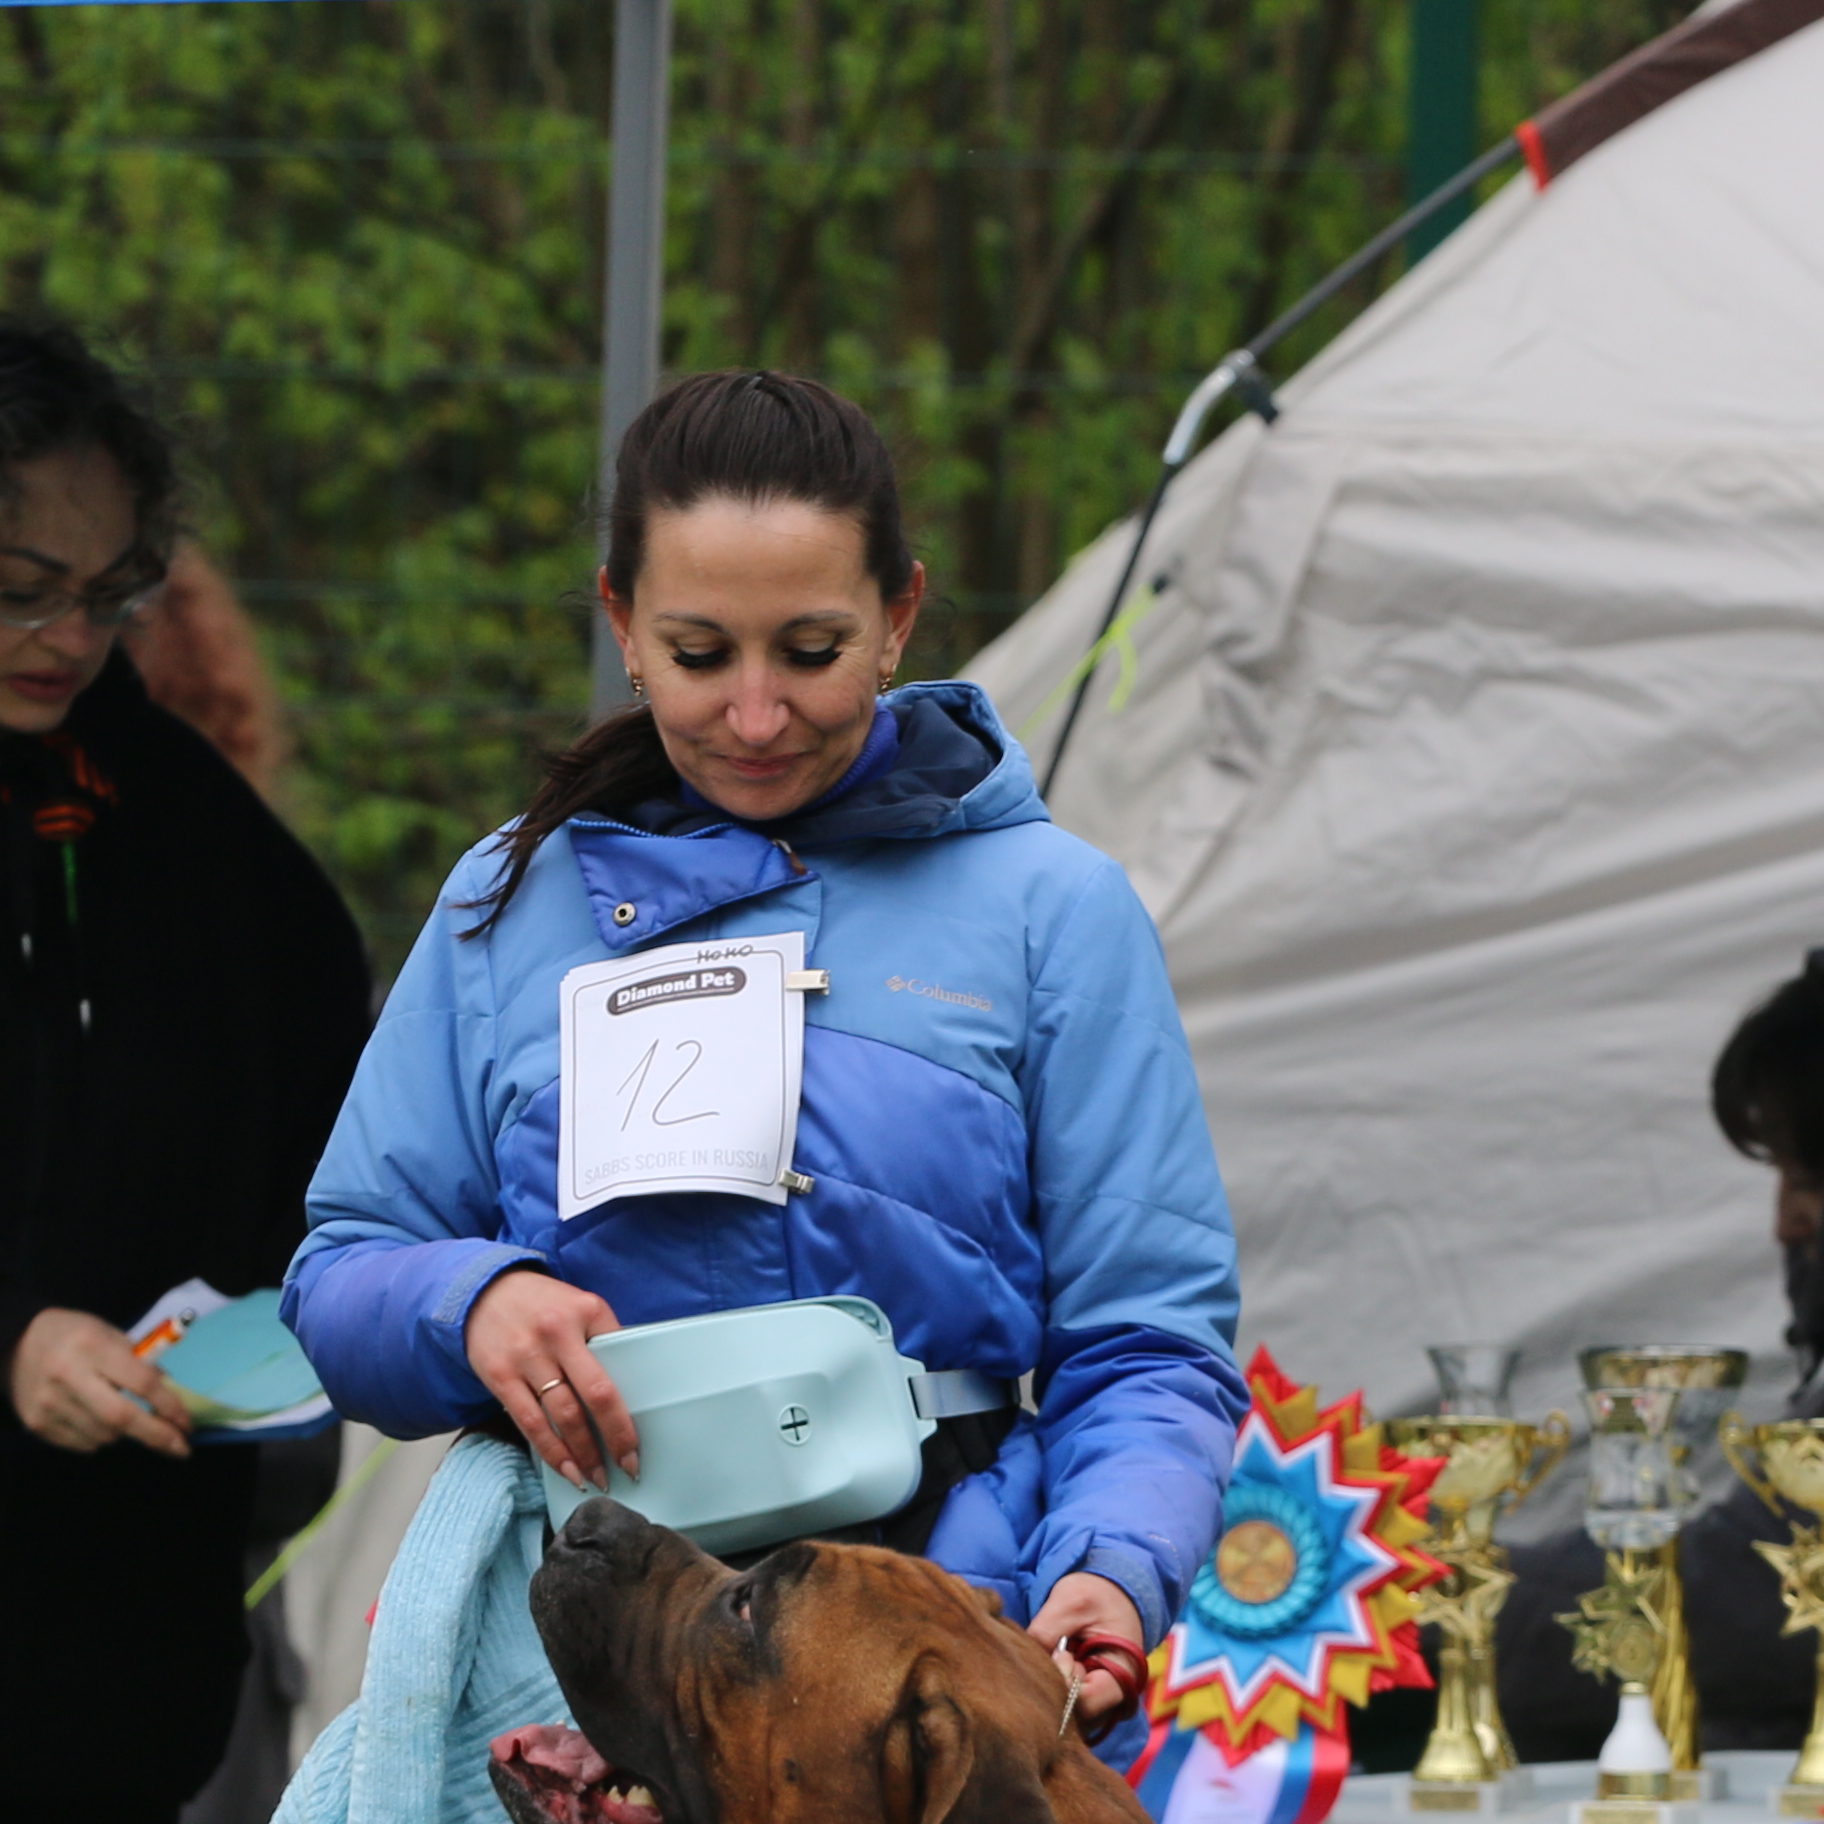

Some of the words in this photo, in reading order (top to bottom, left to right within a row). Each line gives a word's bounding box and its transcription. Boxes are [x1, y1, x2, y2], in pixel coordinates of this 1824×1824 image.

[616, 974, 697, 1007] Diamond
[701, 971, 735, 989] Pet
[907, 979, 993, 1012] Columbia
[616, 1038, 720, 1132] 12
[584, 1156, 631, 1185] SABBS
[635, 1151, 687, 1170] SCORE
[692, 1149, 708, 1165] IN
[713, 1149, 768, 1170] RUSSIA
